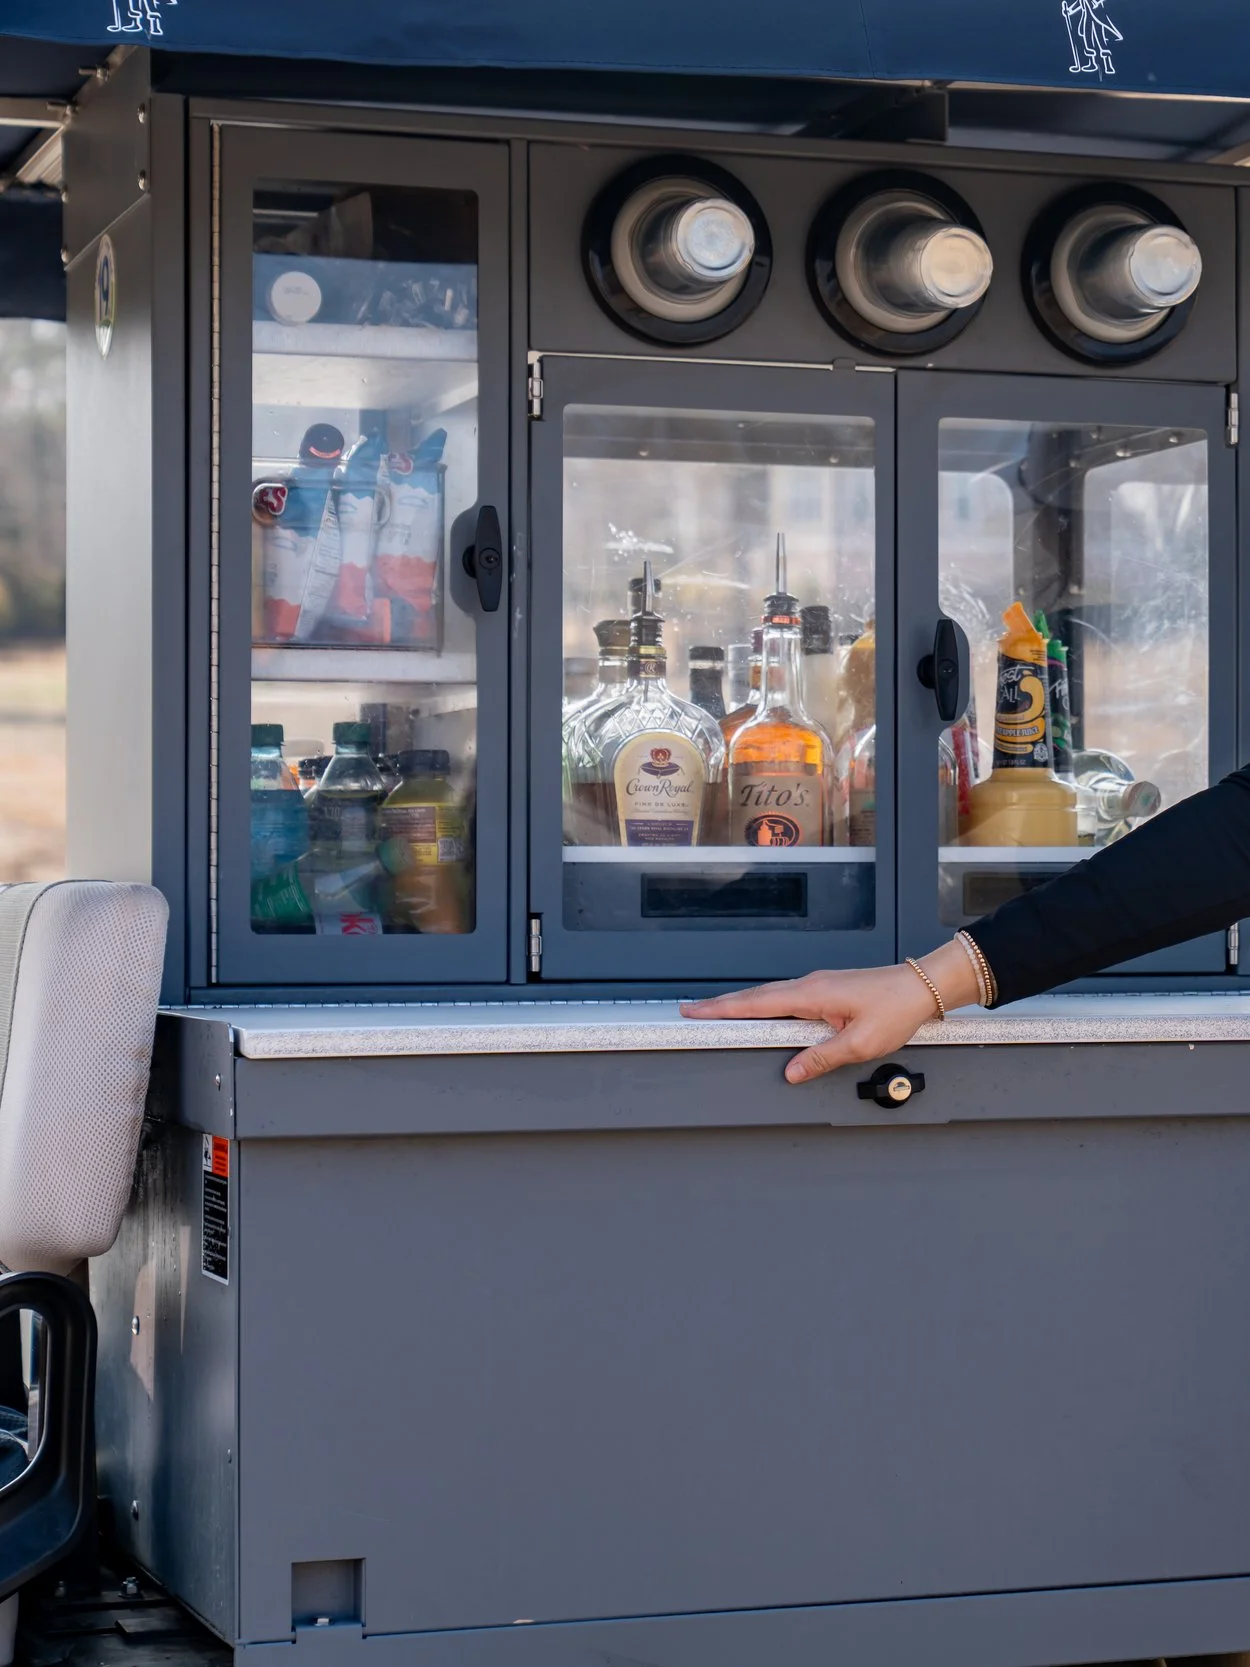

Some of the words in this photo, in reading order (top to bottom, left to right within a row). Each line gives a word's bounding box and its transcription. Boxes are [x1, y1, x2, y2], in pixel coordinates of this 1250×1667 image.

[997, 685, 1021, 703] ALL
[626, 778, 661, 796] Crown
[655, 778, 693, 798] Royal
[740, 781, 809, 807] Tito's
